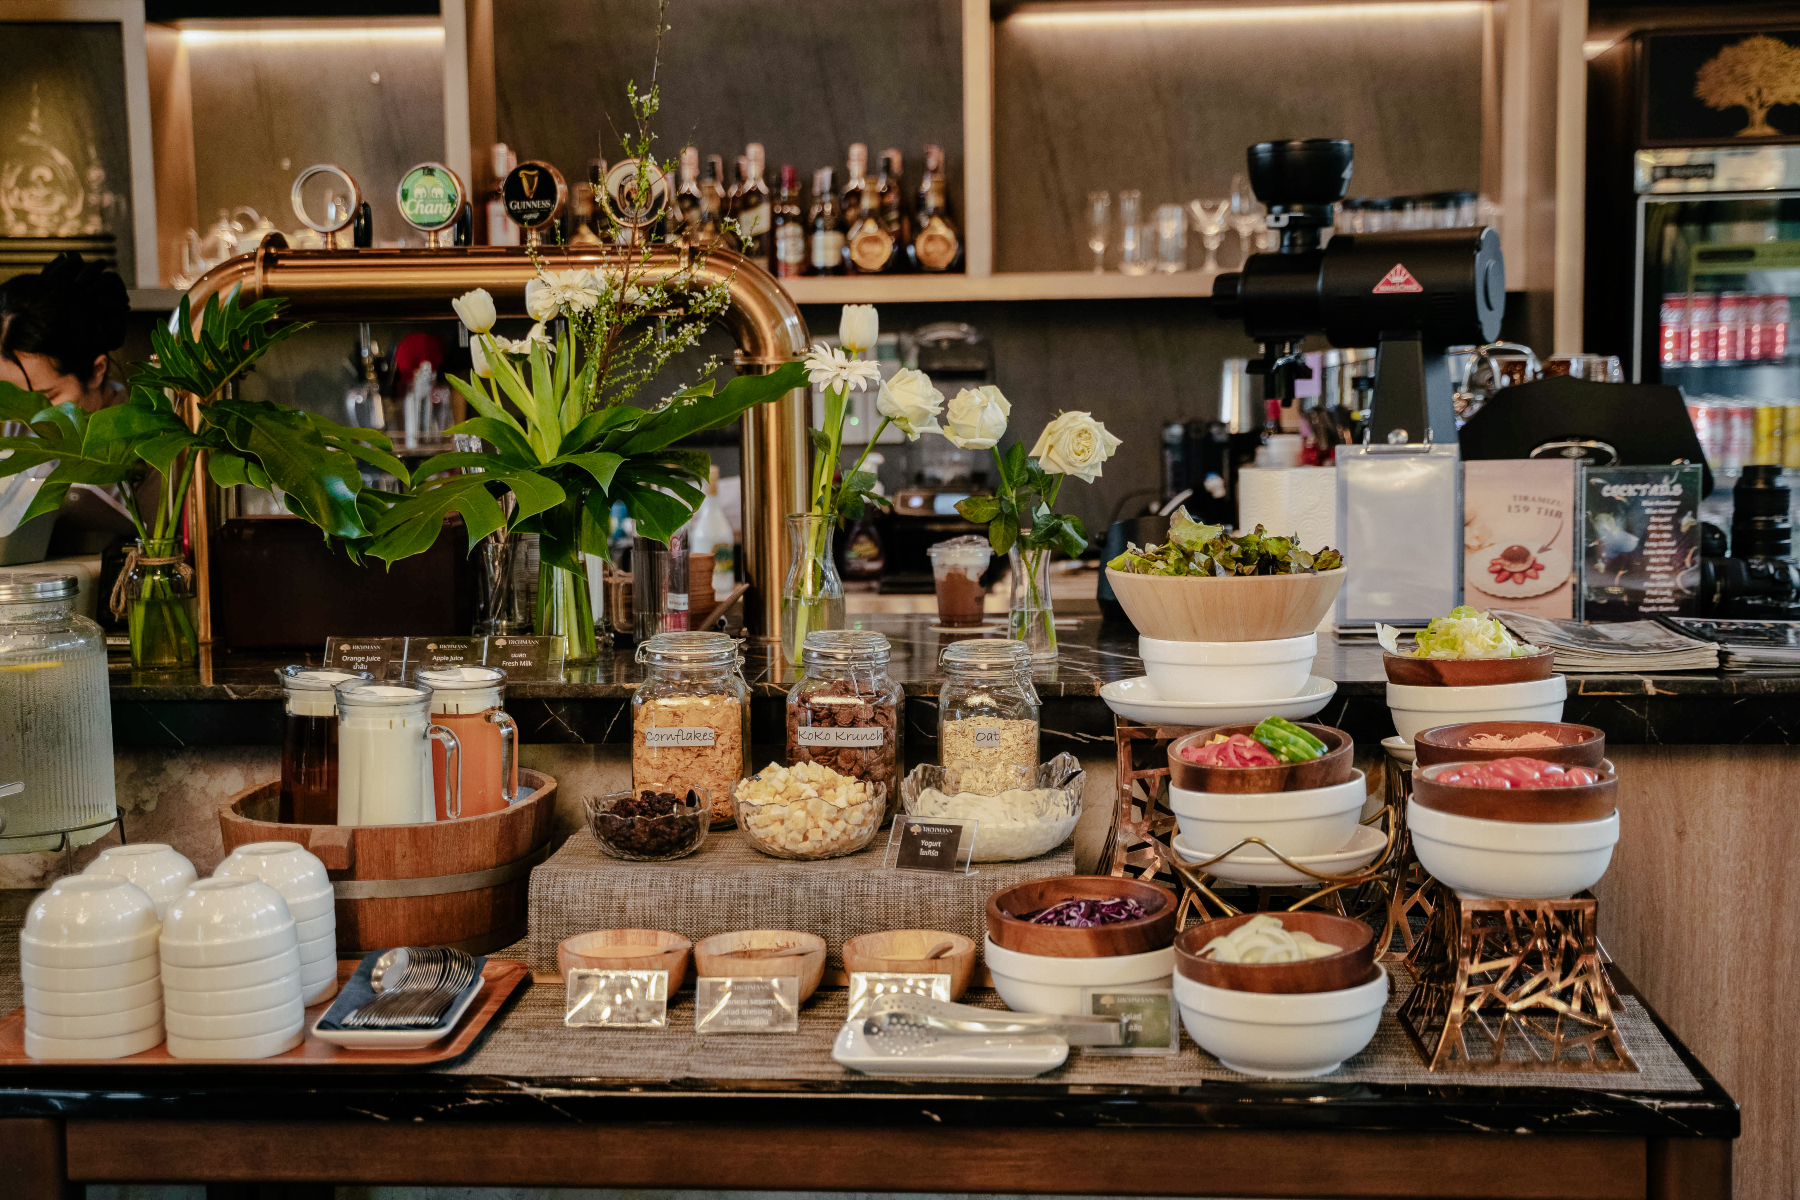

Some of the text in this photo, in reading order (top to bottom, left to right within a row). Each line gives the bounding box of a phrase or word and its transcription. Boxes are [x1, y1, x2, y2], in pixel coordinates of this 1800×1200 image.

[406, 199, 452, 218] Chang
[509, 200, 551, 211] GUINNESS
[1600, 483, 1684, 497] COCKTAILS
[1507, 504, 1564, 519] 159 THB
[645, 728, 715, 745] Cornflakes
[835, 729, 883, 741] Krunch
[975, 731, 1000, 742] Oat
[920, 839, 942, 848] Yogurt
[720, 1008, 773, 1018] salad dressing
